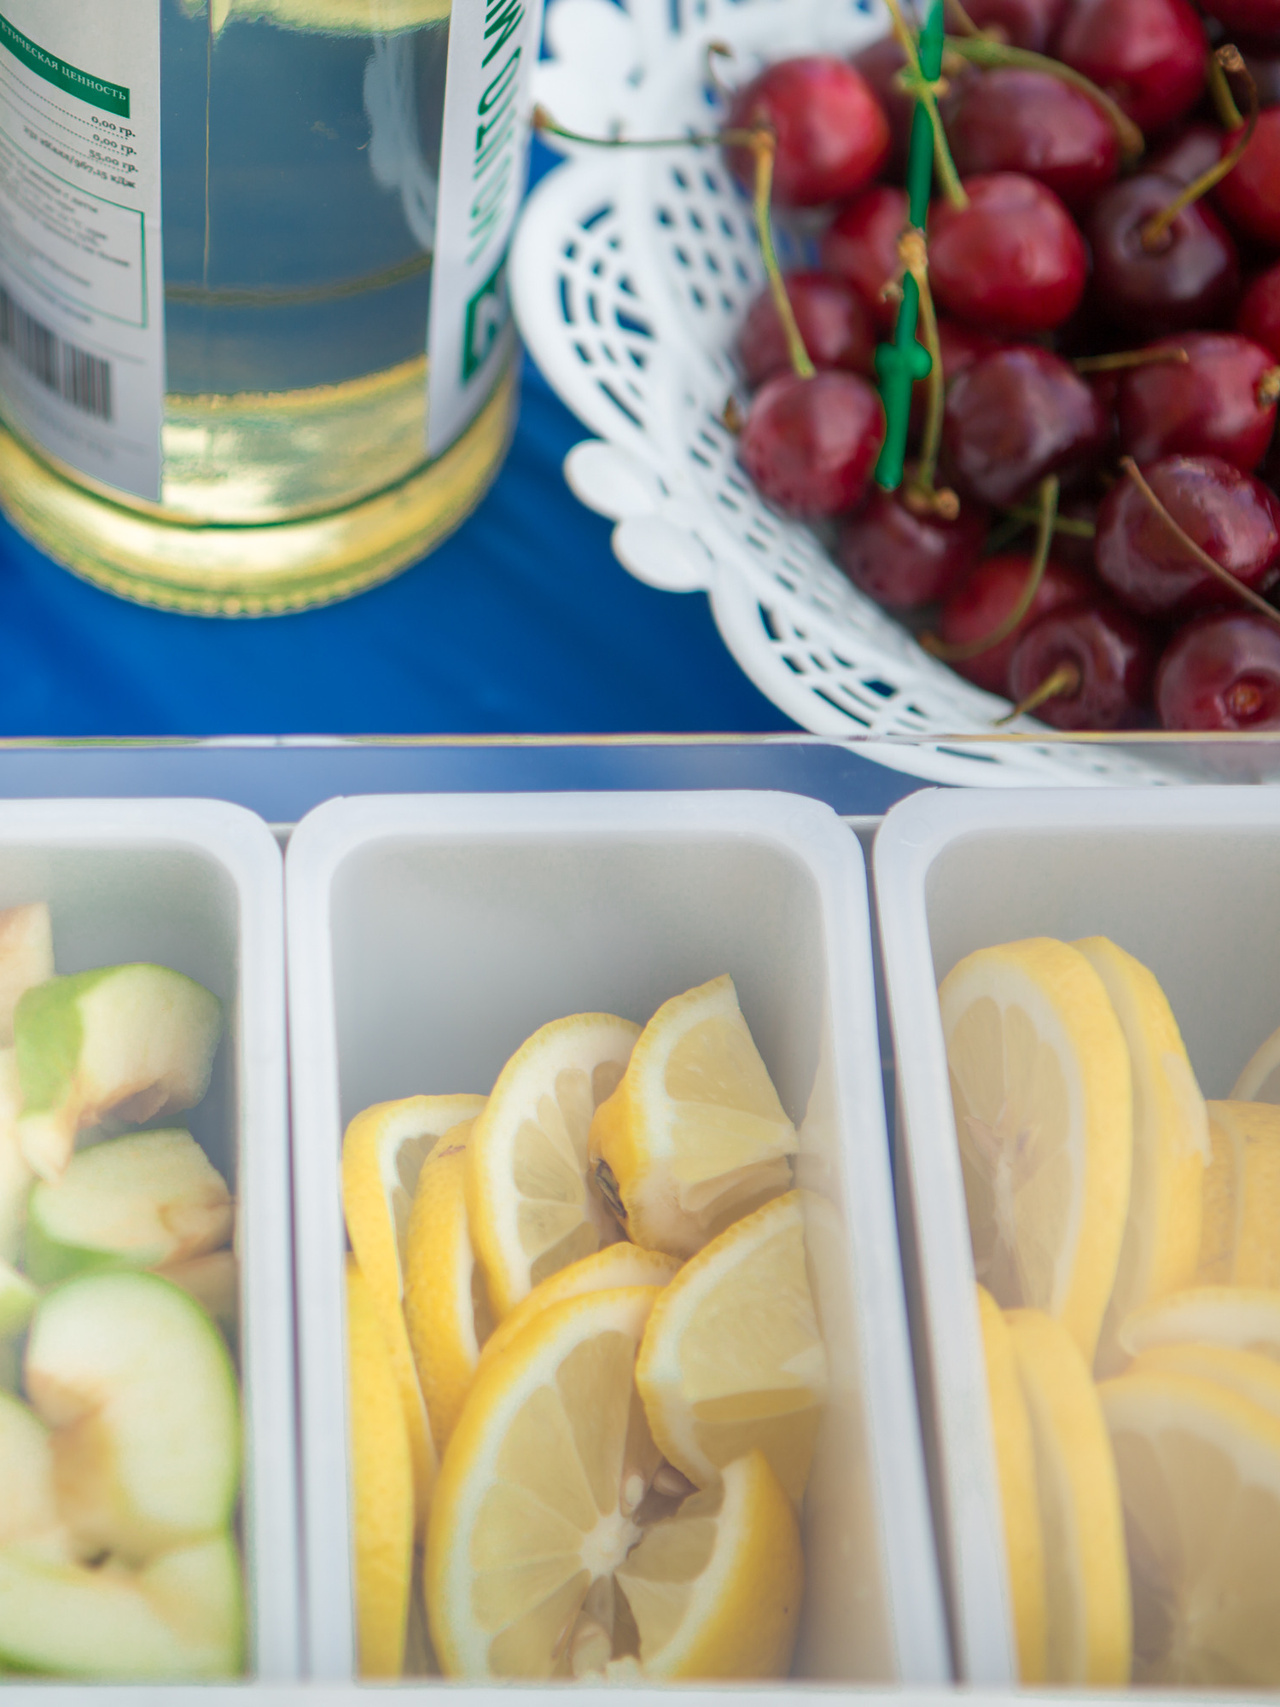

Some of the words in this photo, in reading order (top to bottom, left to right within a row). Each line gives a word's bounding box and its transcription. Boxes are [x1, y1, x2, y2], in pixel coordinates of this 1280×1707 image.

[62, 65, 127, 101] ЦЕННОСТЬ
[91, 115, 117, 131] 0,00
[119, 124, 136, 138] гр.
[92, 133, 118, 149] 0,00
[120, 142, 137, 156] гр.
[88, 148, 120, 167] 55,00
[122, 160, 139, 174] гр.
